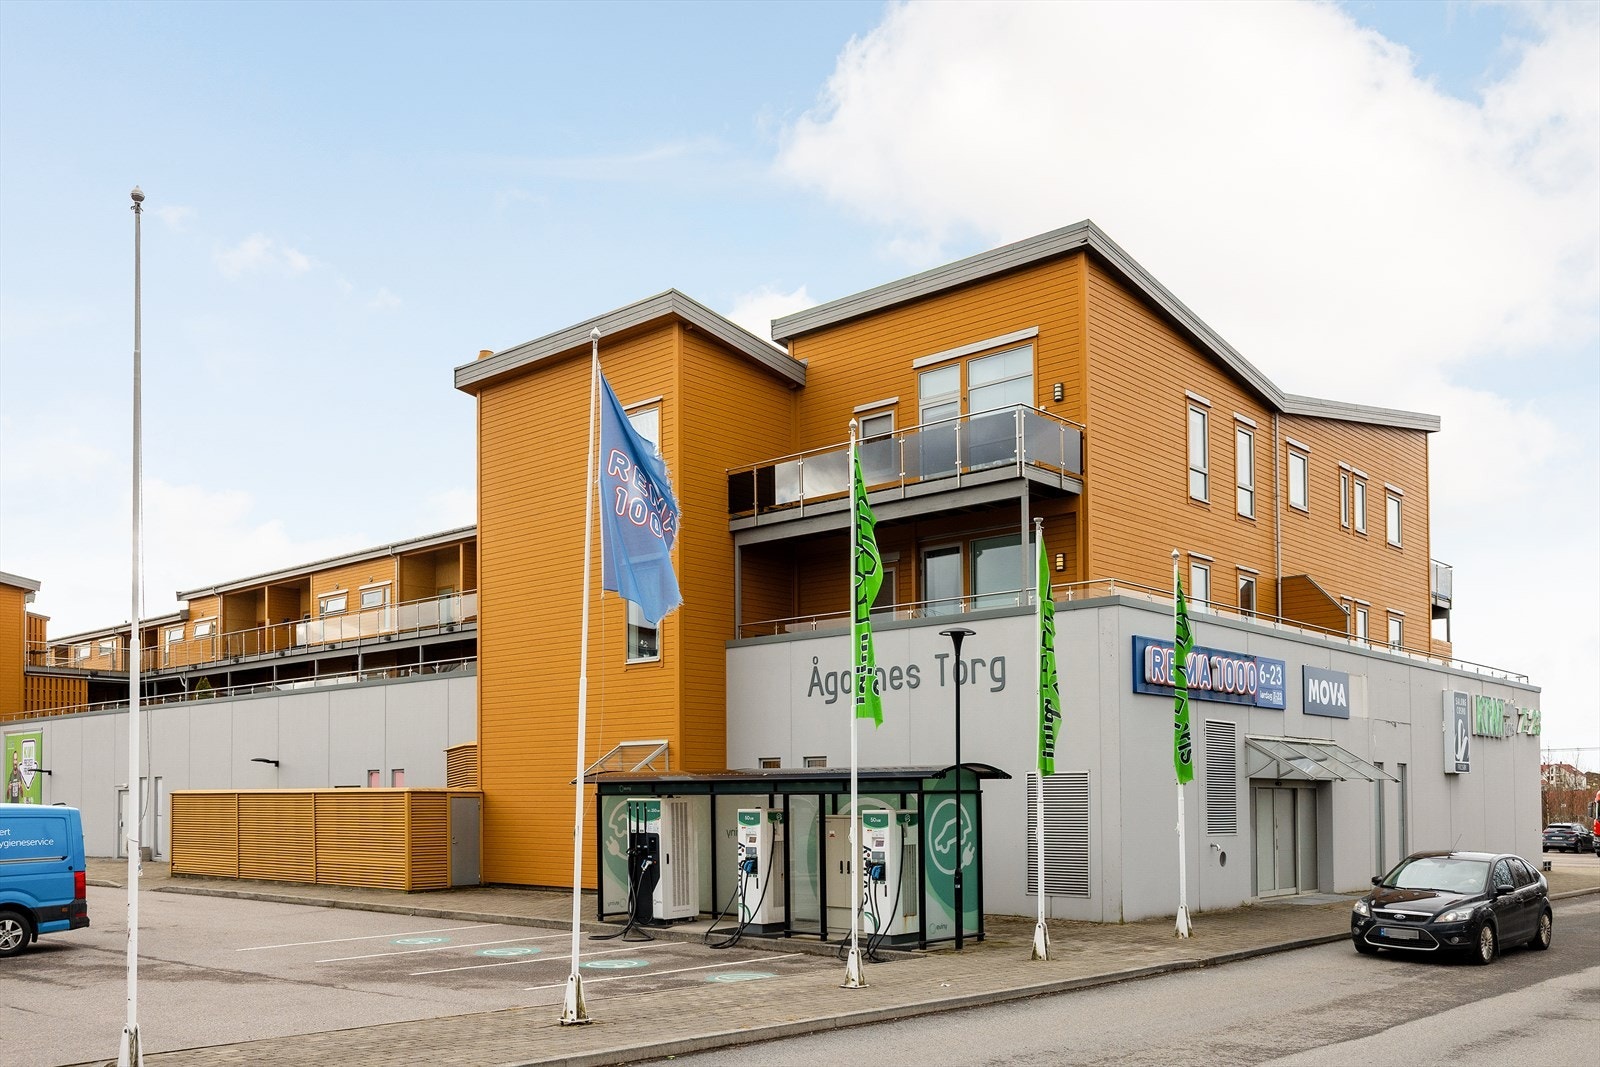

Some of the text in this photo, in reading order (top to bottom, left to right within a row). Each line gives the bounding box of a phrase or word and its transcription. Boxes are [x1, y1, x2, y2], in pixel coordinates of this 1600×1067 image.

[607, 448, 677, 537] REMA
[615, 486, 664, 538] 100
[807, 655, 921, 705] Ågones
[934, 652, 1007, 693] Torg
[1146, 646, 1258, 695] REMA 1000
[1259, 664, 1282, 686] 6-23
[1308, 678, 1347, 708] MOVA
